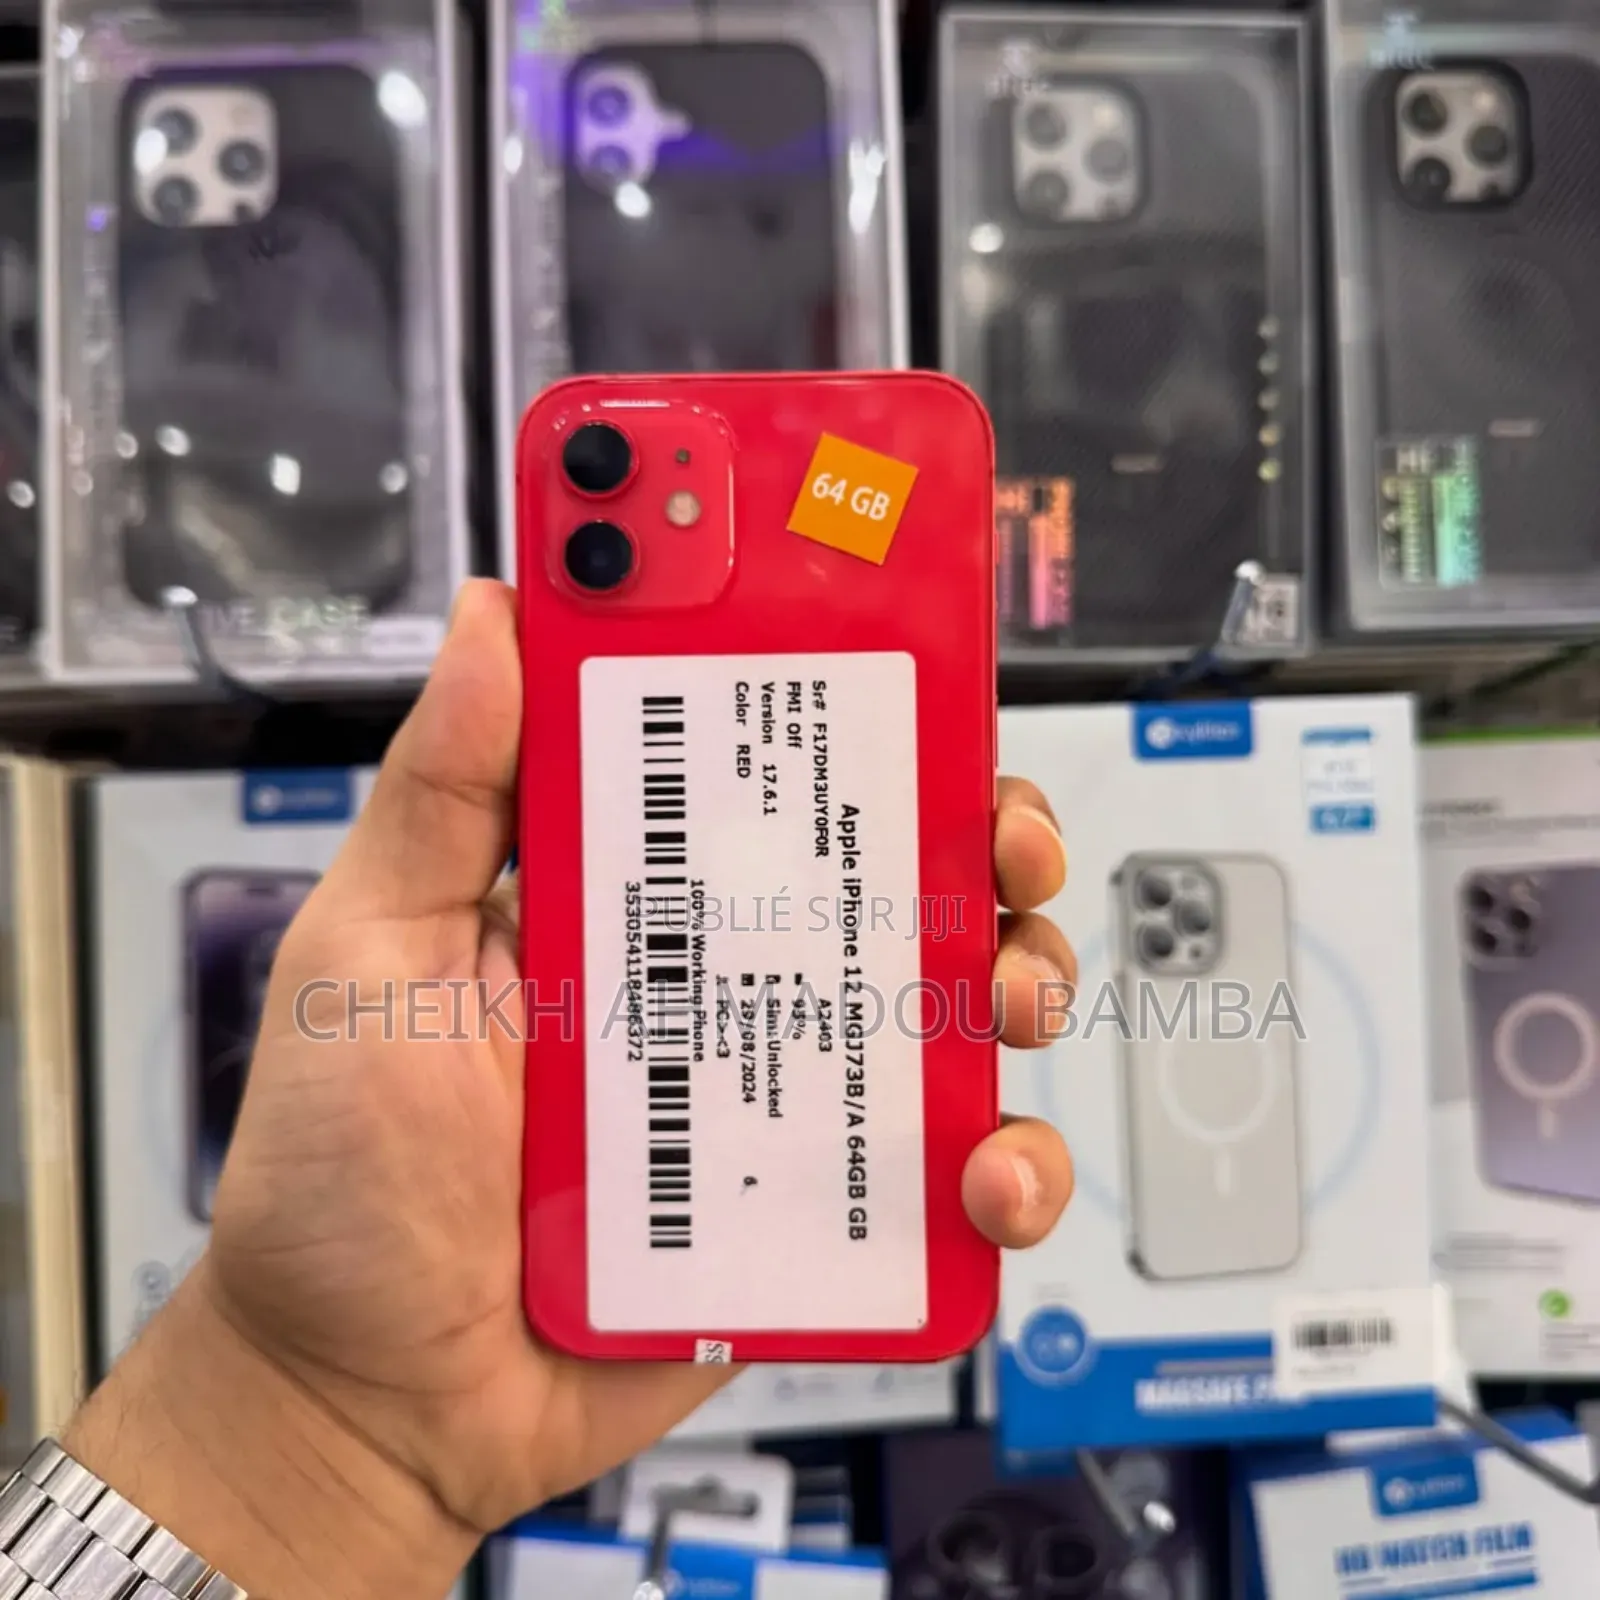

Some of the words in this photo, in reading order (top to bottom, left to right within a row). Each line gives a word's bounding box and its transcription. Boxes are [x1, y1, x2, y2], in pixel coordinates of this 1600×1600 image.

[811, 472, 848, 506] 64
[850, 485, 891, 521] GB
[735, 681, 750, 726] Color
[761, 681, 776, 744] Version
[787, 681, 802, 714] FMI
[812, 680, 828, 711] Sr#
[737, 743, 751, 779] RED
[787, 722, 803, 749] Off
[763, 763, 778, 816] 17.6.1
[837, 803, 861, 870] Apple
[688, 879, 706, 930] 100%
[843, 878, 862, 957] iPhone
[688, 934, 708, 1006] Working
[845, 965, 863, 994] 12
[691, 1010, 709, 1064] Phone
[738, 998, 757, 1104] 29/08/2024
[818, 998, 833, 1053] A2403
[767, 1040, 784, 1119] Unlocked
[843, 1001, 866, 1128] MGJ73B/A
[847, 1135, 867, 1200] 64GB
[848, 1206, 868, 1242] GB
